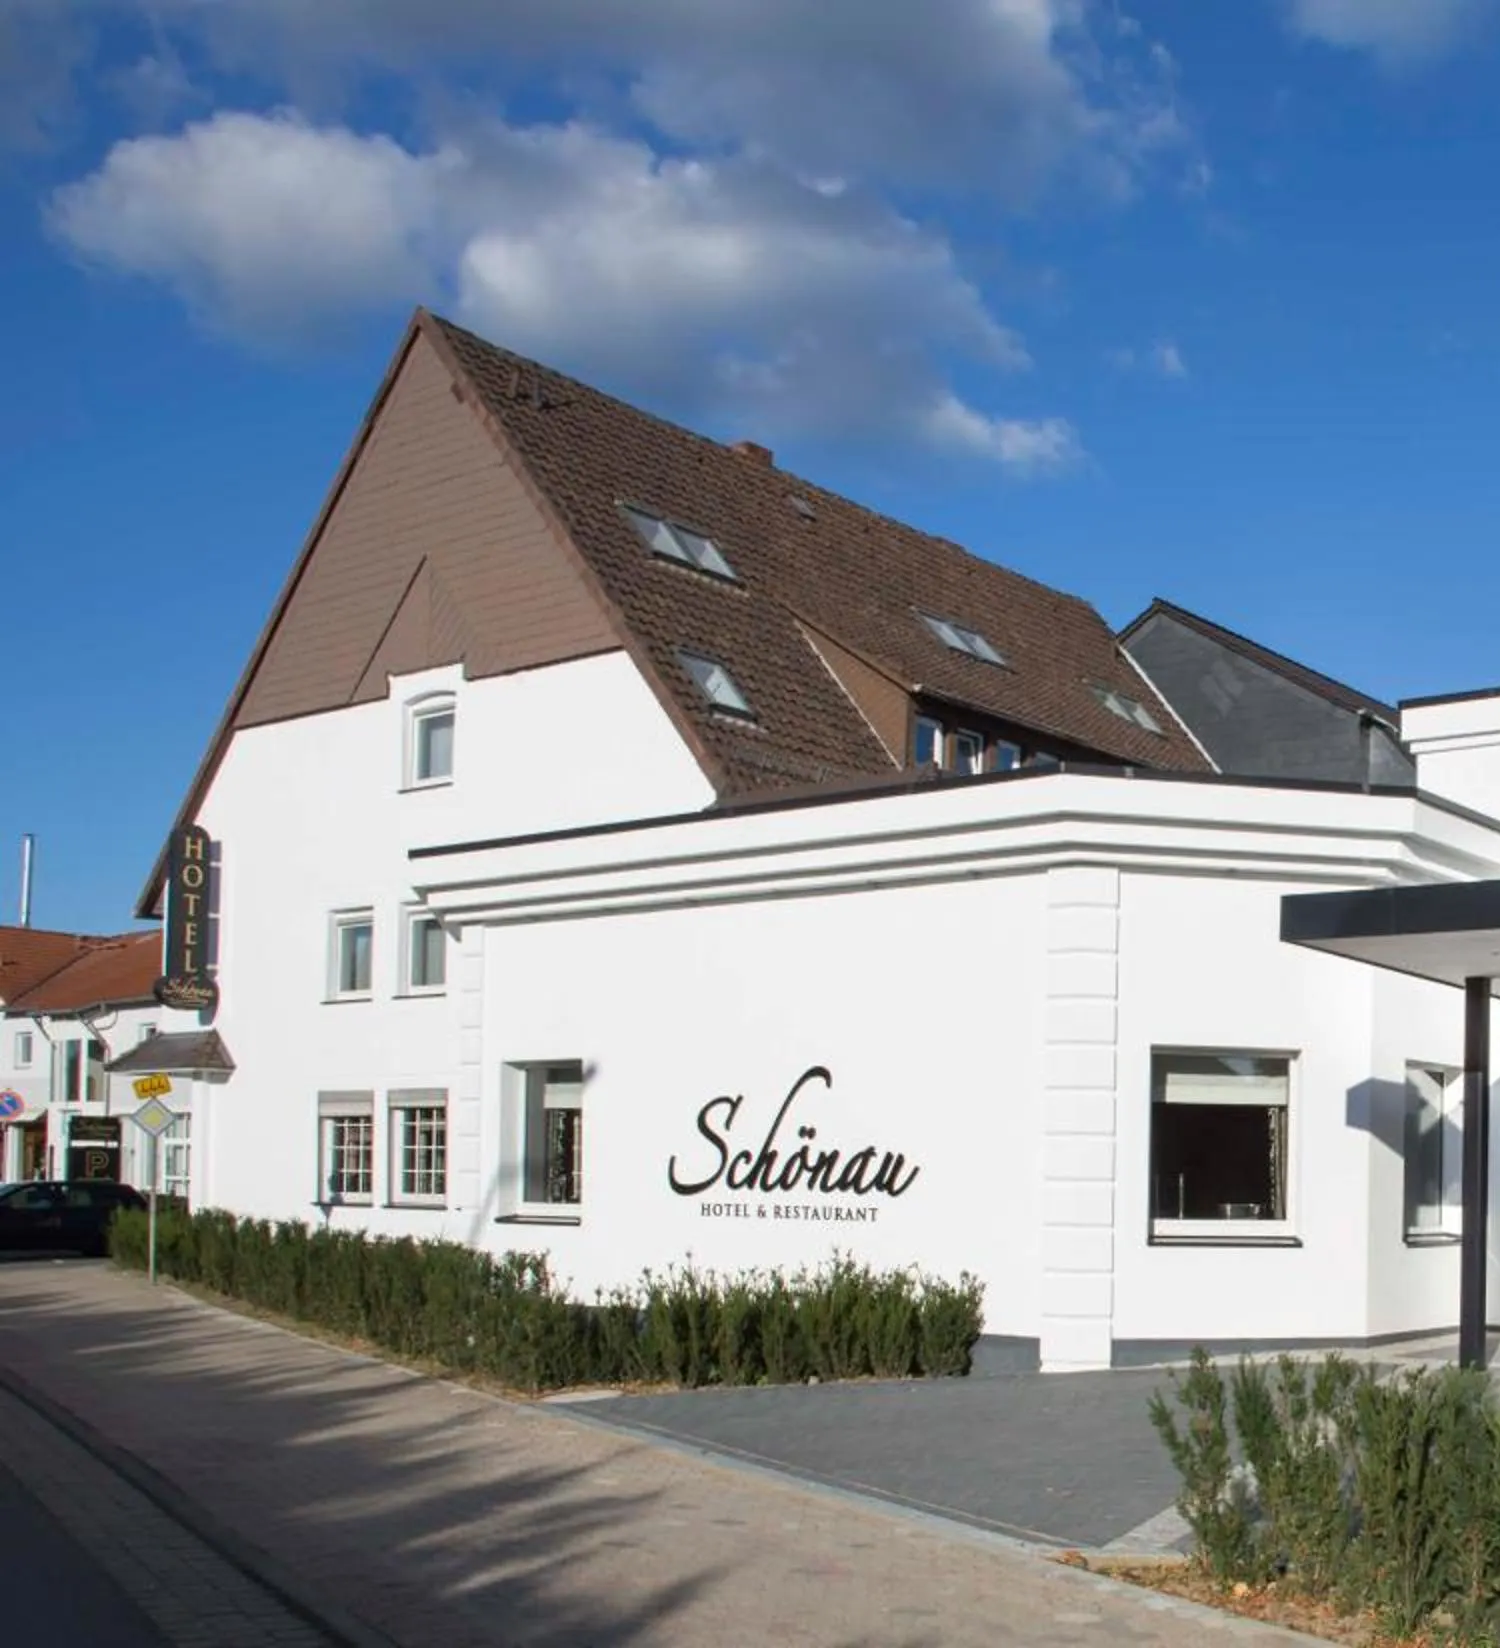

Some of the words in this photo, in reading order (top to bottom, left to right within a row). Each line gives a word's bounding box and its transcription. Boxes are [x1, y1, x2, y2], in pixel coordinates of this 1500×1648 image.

[182, 836, 203, 973] HOTEL
[85, 1150, 109, 1177] P
[668, 1065, 920, 1196] Schönau
[701, 1203, 750, 1218] HOTEL
[757, 1204, 767, 1218] &
[773, 1205, 879, 1222] RESTAURANT
